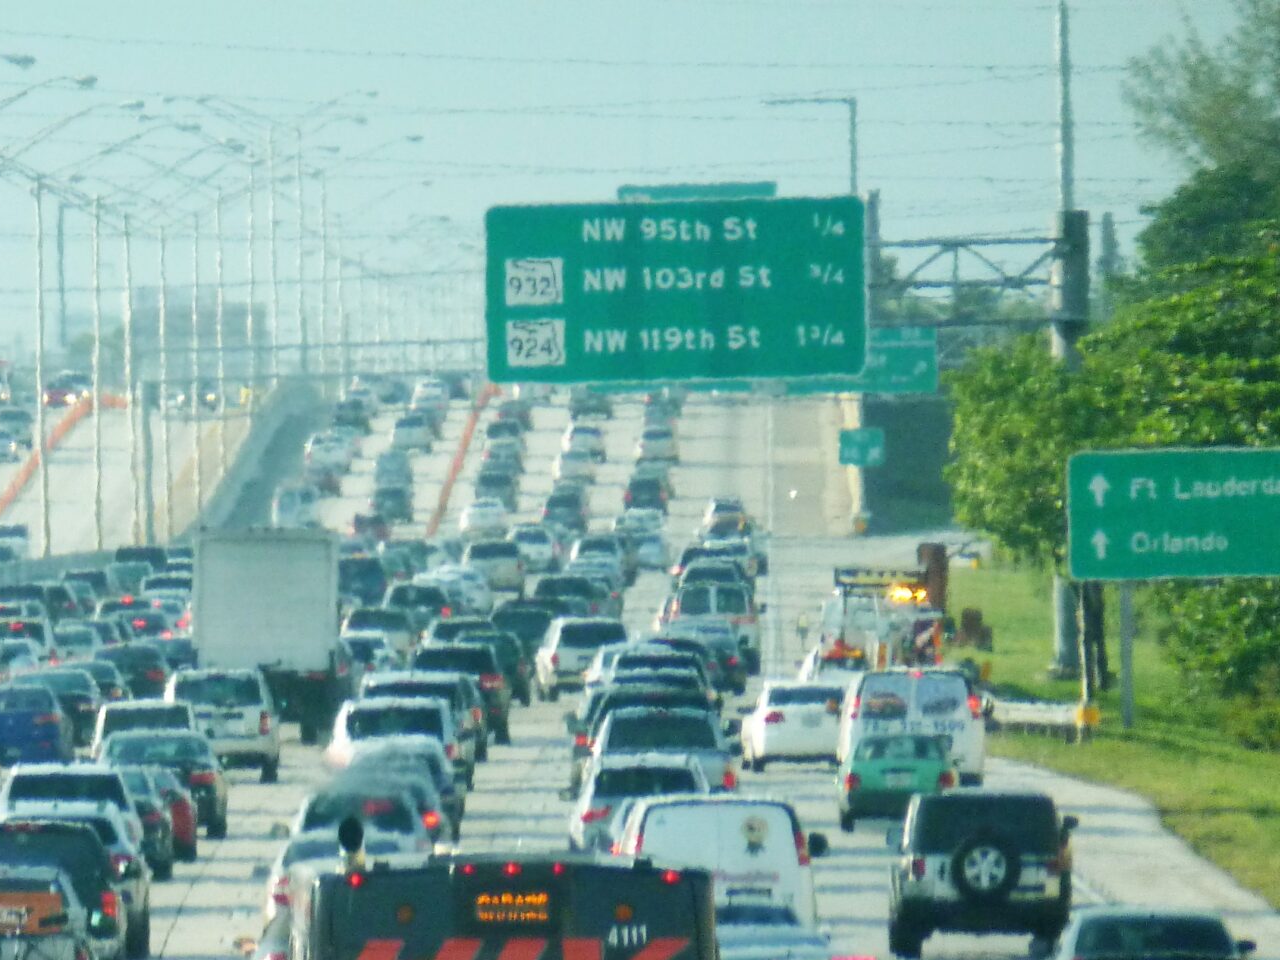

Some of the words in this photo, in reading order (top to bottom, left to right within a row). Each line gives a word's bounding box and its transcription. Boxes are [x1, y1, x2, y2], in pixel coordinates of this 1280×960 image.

[582, 218, 626, 242] NW
[640, 217, 711, 241] 95th
[722, 216, 757, 240] St
[509, 276, 552, 296] 932
[583, 267, 627, 292] NW
[642, 266, 725, 290] 103rd
[738, 265, 772, 289] St
[510, 337, 554, 358] 924
[583, 329, 628, 353] NW
[639, 326, 715, 351] 119th
[727, 325, 761, 349] St
[1130, 476, 1157, 500] Ft
[1131, 530, 1229, 554] Orlando
